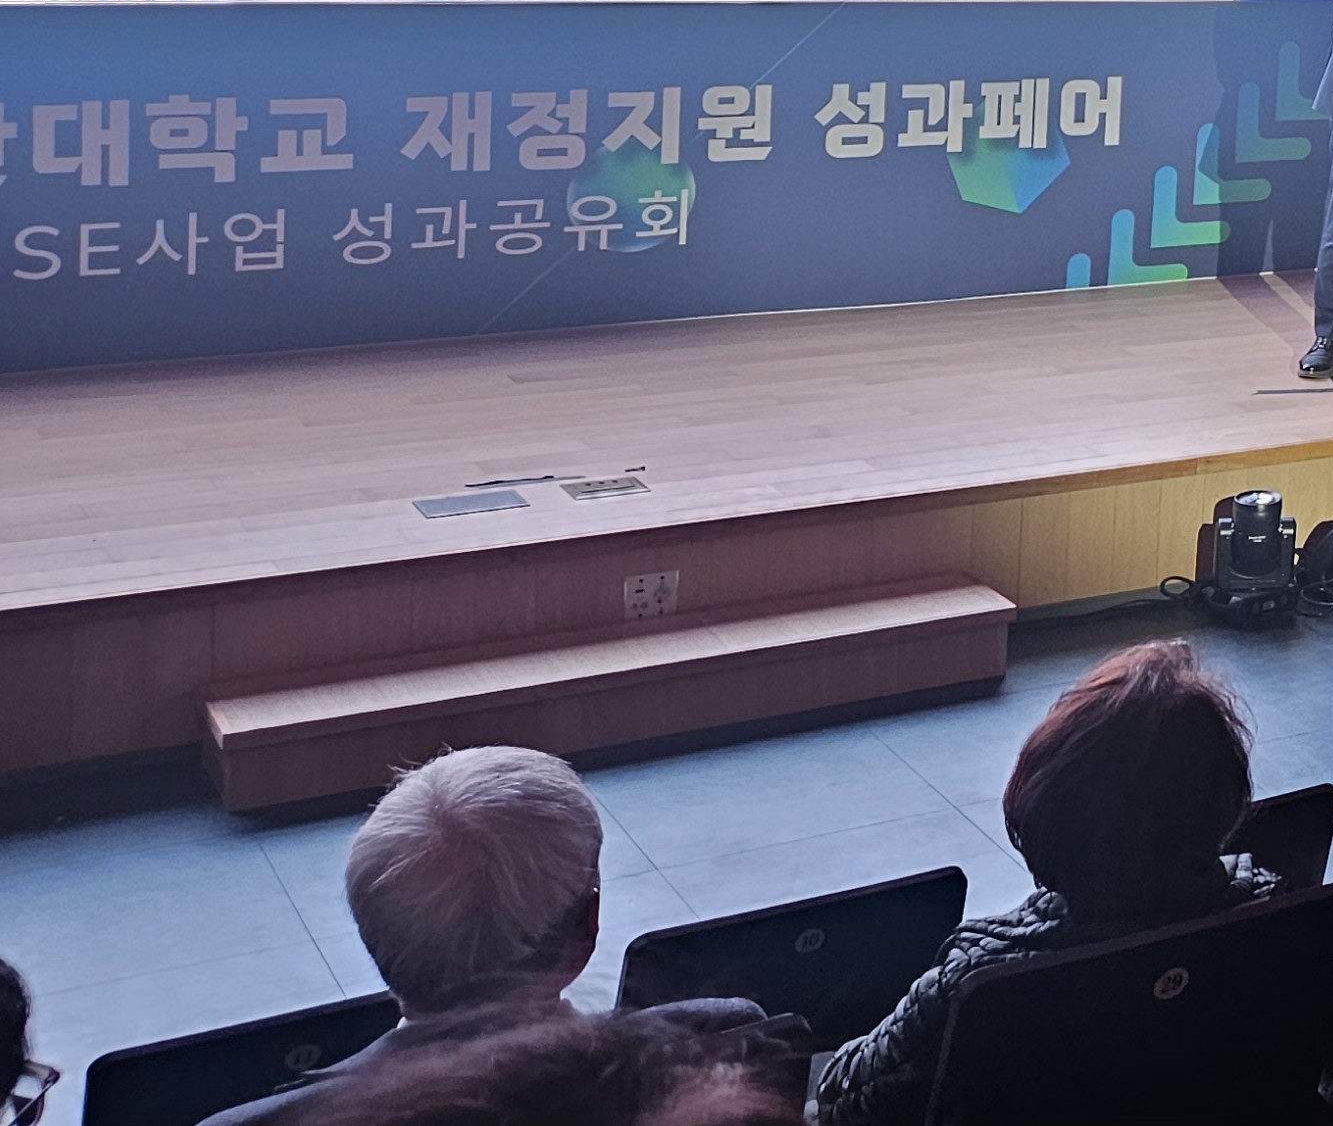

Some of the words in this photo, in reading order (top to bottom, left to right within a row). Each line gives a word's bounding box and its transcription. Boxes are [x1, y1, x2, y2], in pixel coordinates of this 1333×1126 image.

[0, 93, 355, 187] 대학교
[400, 84, 773, 172] 재정지원
[813, 76, 1123, 159] 성과페어
[332, 188, 690, 266] 성과공유회
